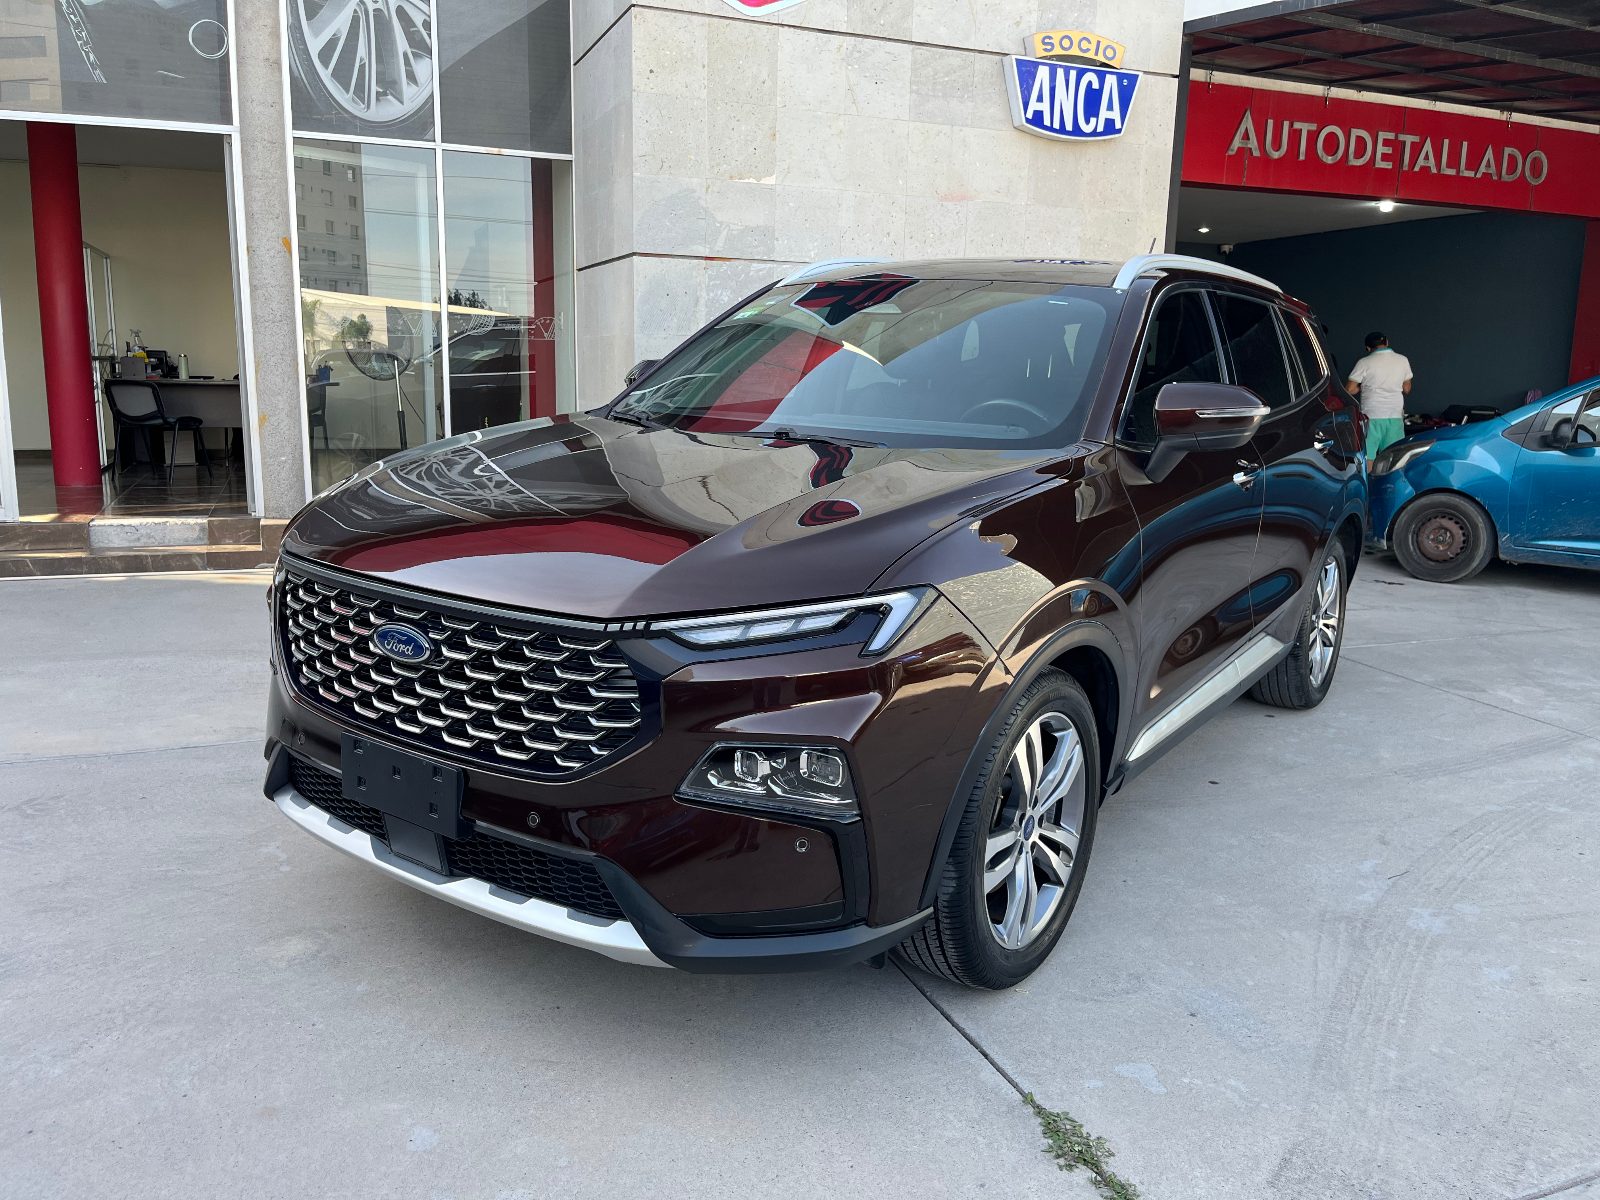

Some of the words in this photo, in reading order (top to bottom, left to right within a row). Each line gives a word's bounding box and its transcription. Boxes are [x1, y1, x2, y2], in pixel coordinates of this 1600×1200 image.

[1041, 35, 1117, 61] SOCIO
[1025, 65, 1122, 133] ANCA
[1227, 109, 1548, 186] AUTODETALLADO
[384, 632, 415, 656] Ford
